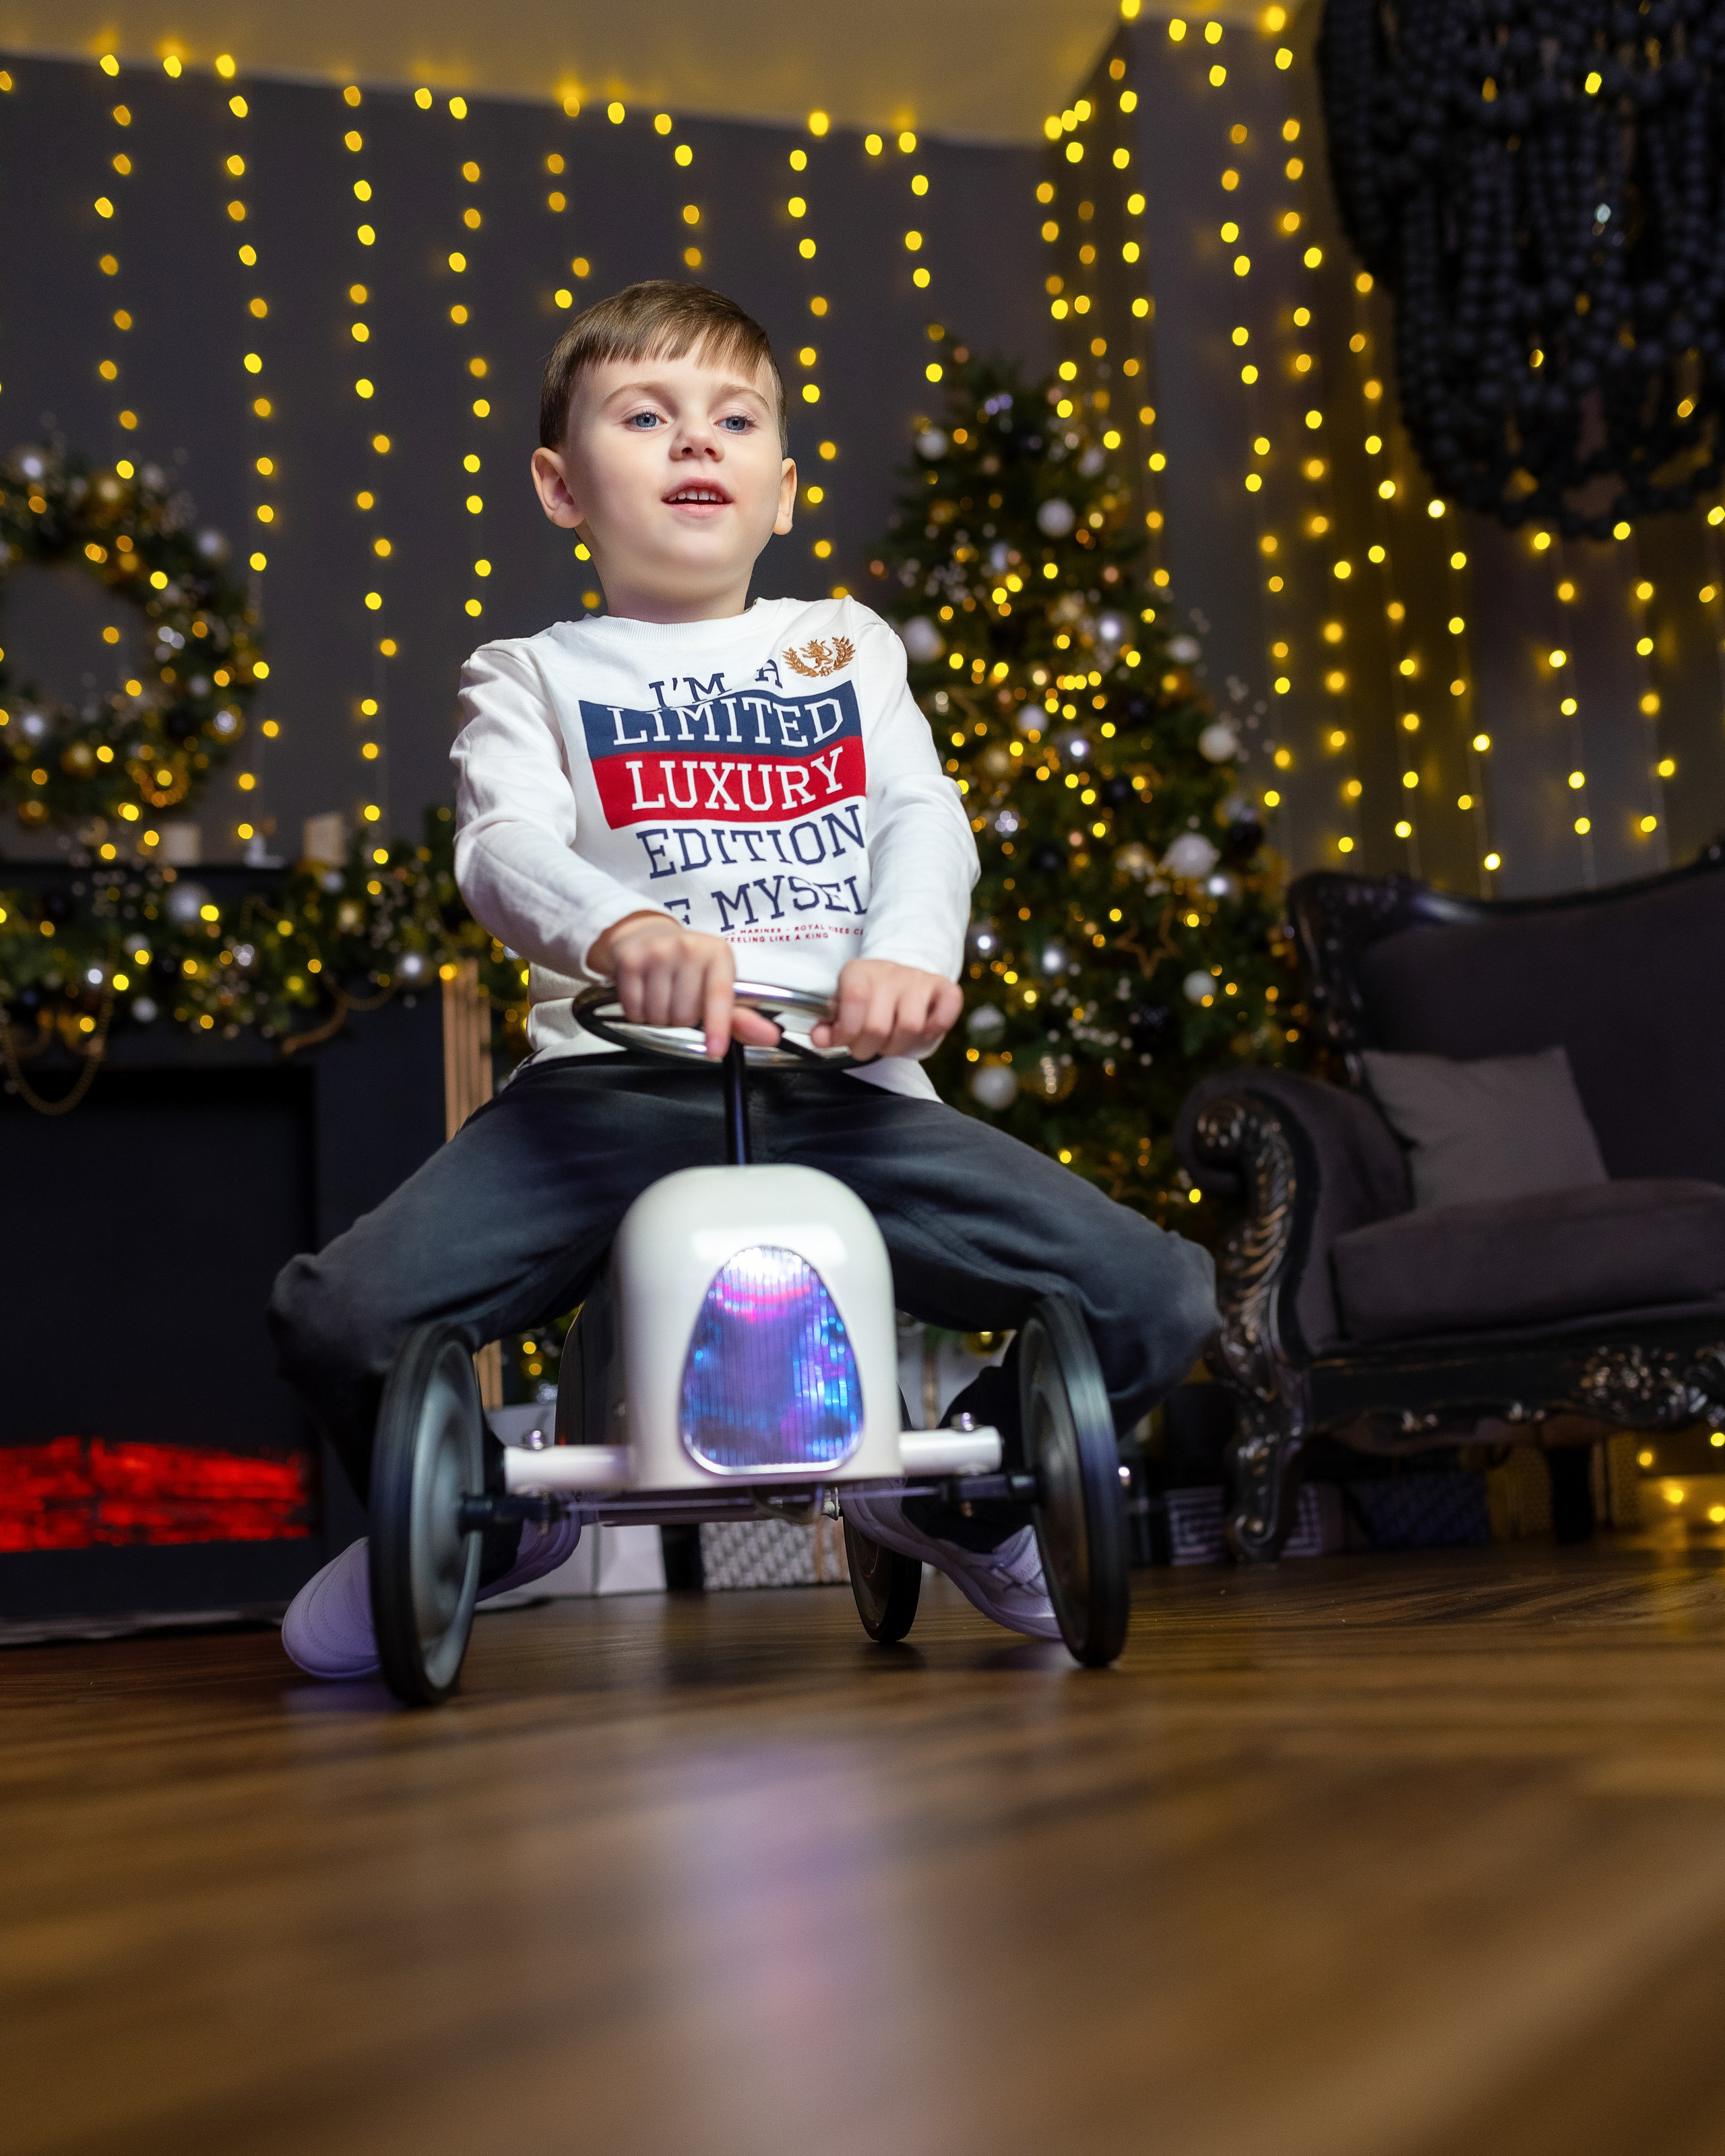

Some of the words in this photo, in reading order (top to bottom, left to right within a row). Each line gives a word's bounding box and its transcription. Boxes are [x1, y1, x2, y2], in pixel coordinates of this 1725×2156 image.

[648, 672, 732, 709] I'M
[755, 659, 783, 689] A
[606, 697, 843, 747] LIMITED
[626, 747, 843, 811] LUXURY
[636, 804, 866, 879] EDITION
